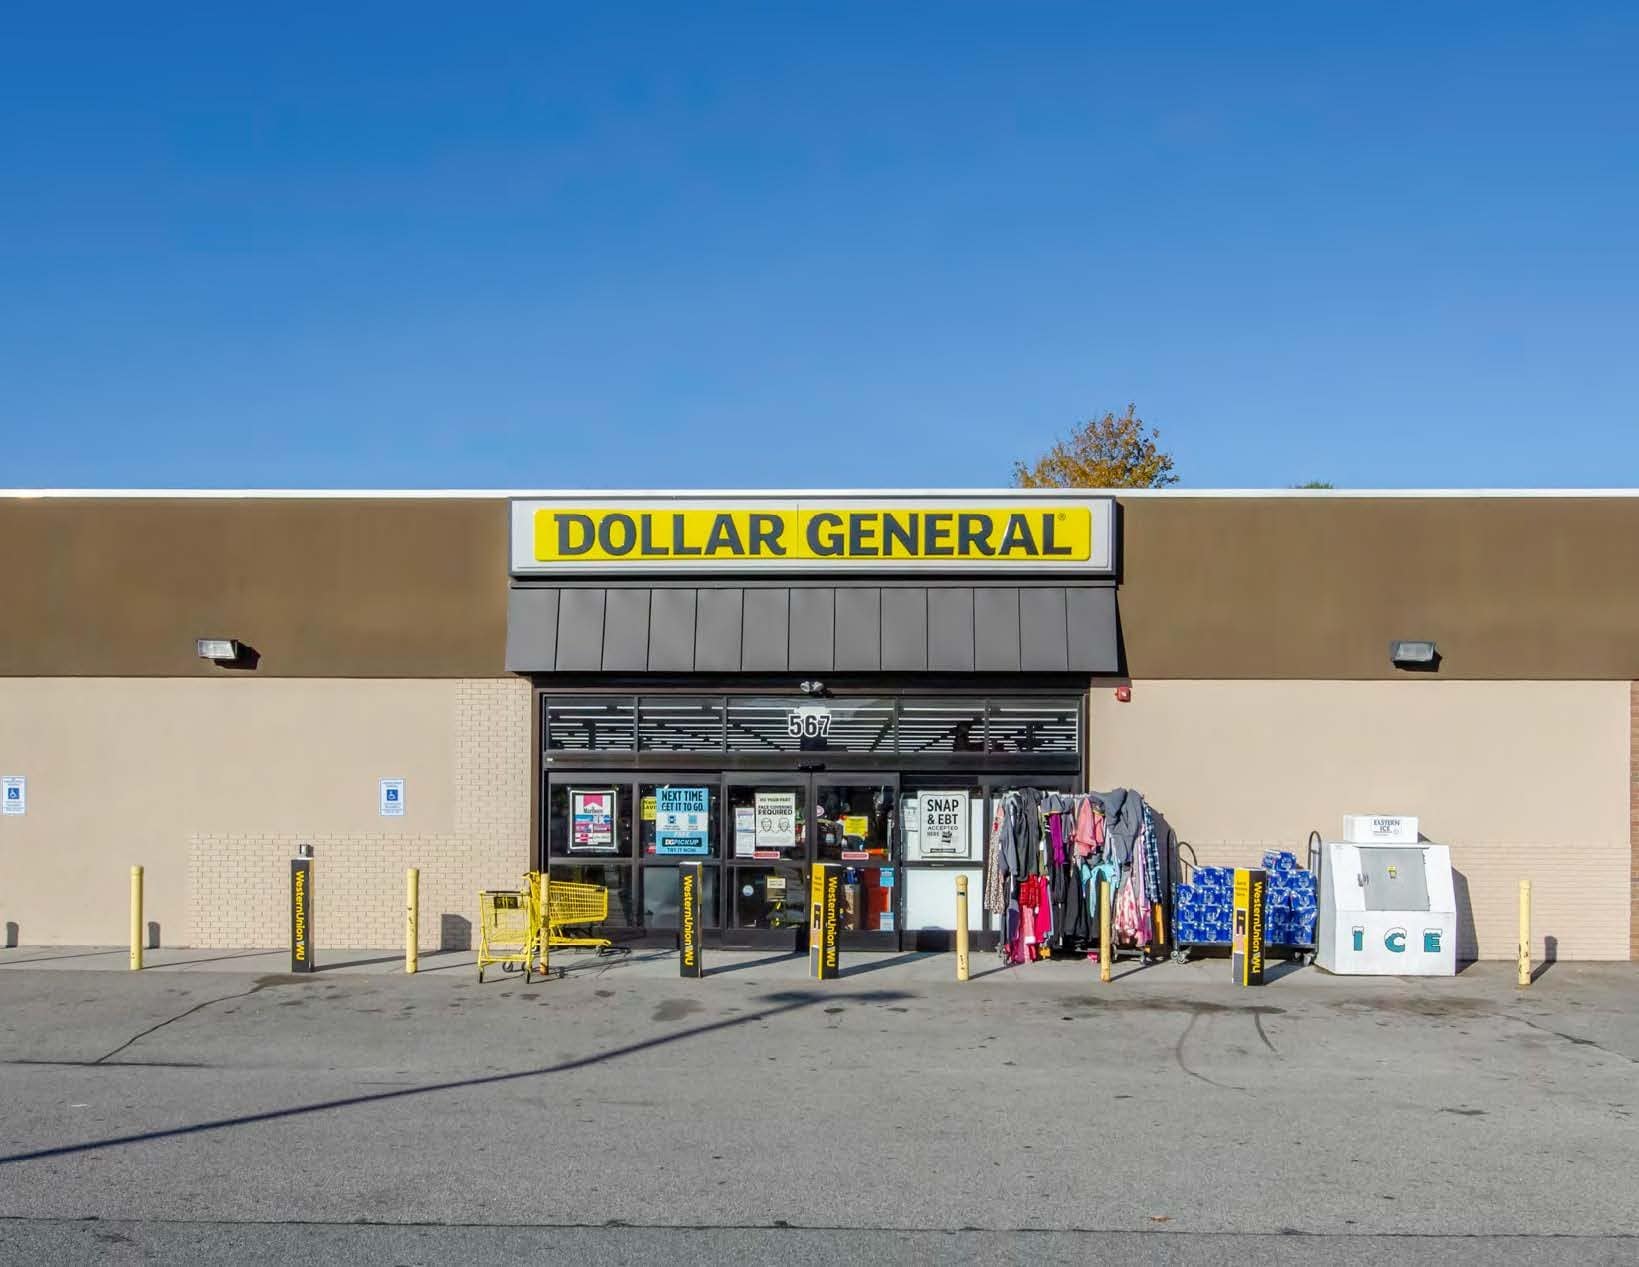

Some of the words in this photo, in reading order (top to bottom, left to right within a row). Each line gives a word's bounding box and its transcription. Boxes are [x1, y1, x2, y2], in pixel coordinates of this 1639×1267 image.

[554, 513, 787, 556] DOLLAR
[806, 512, 1072, 556] GENERAL
[788, 713, 831, 738] 567
[661, 790, 682, 801] NEXT
[685, 790, 703, 801] TIME
[661, 802, 673, 811] GET
[674, 802, 682, 811] IT
[683, 802, 692, 811] TO
[927, 799, 959, 812] SNAP
[927, 814, 935, 825] &
[938, 813, 959, 825] EBT
